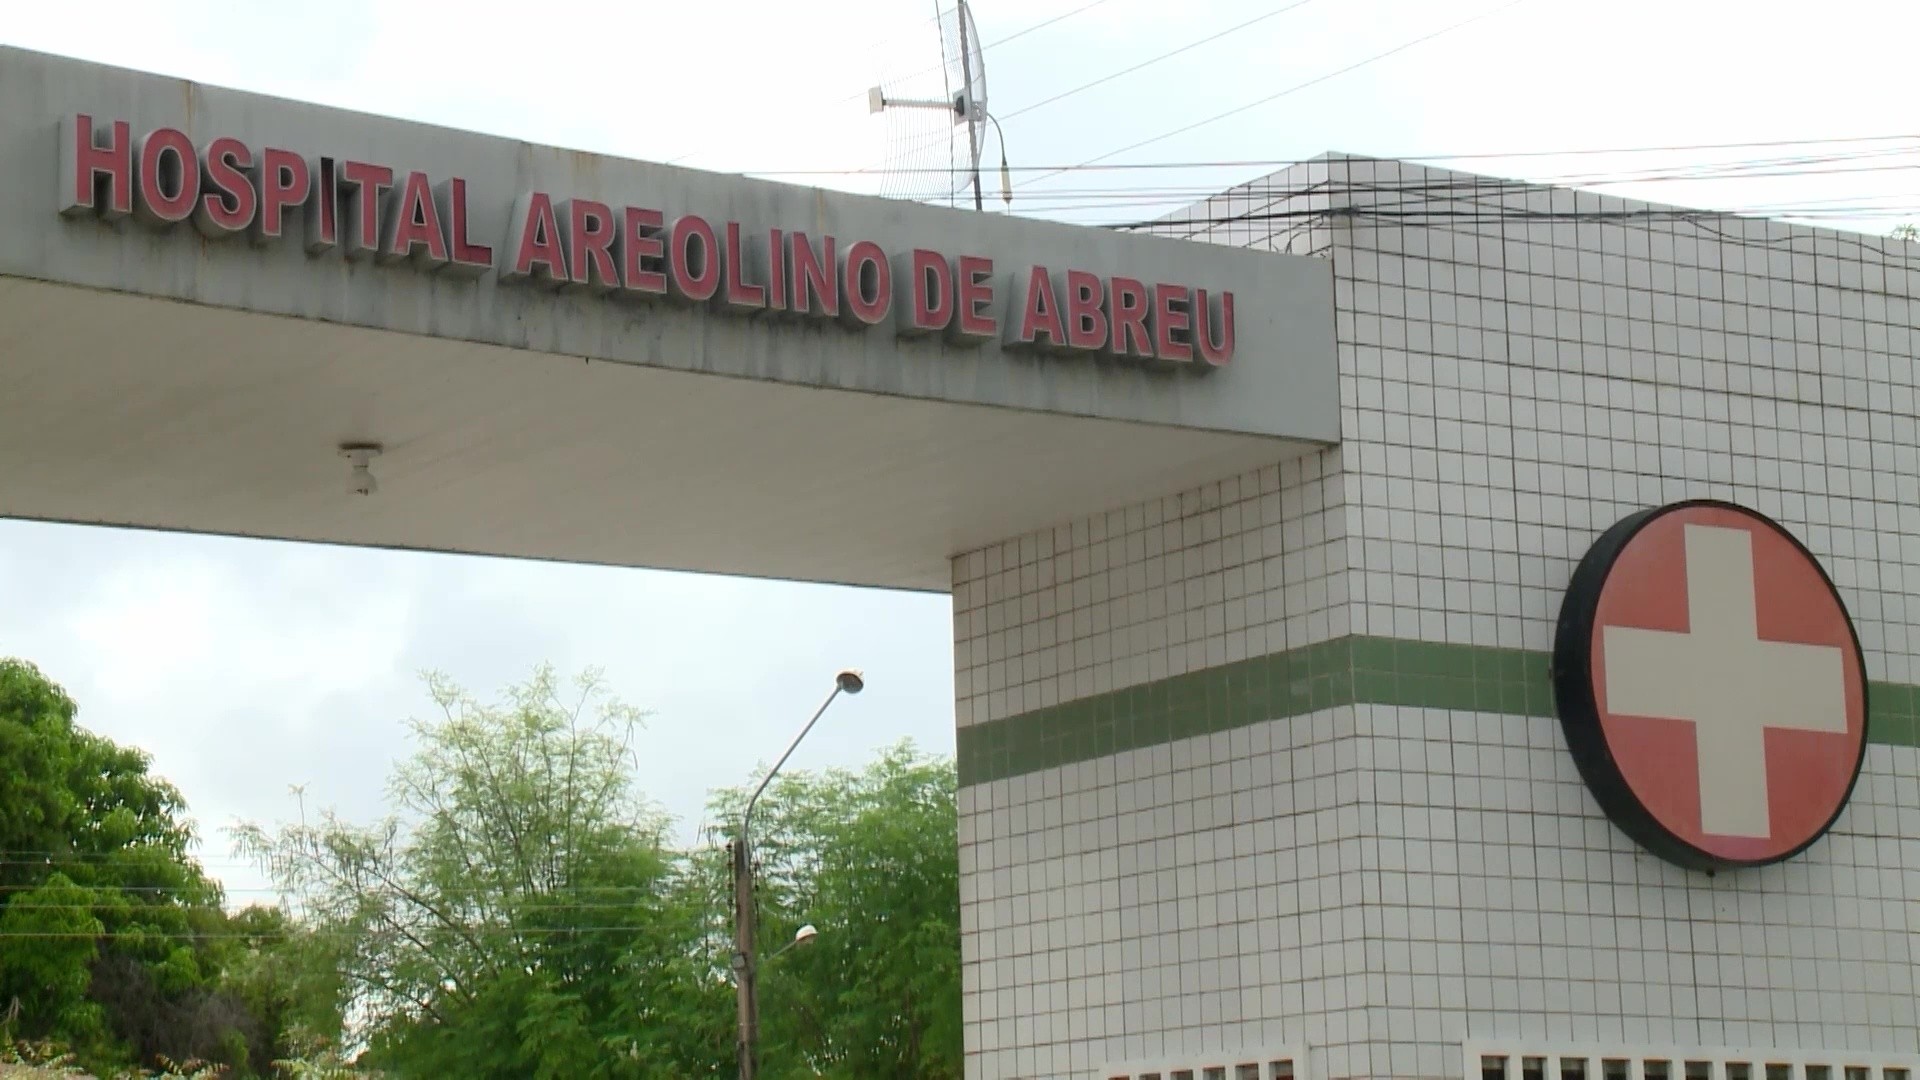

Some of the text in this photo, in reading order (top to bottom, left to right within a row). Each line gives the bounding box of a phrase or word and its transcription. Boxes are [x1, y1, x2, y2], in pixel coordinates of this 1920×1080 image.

[73, 112, 1236, 366] HOSPITAL AREOLINO DE ABREU
